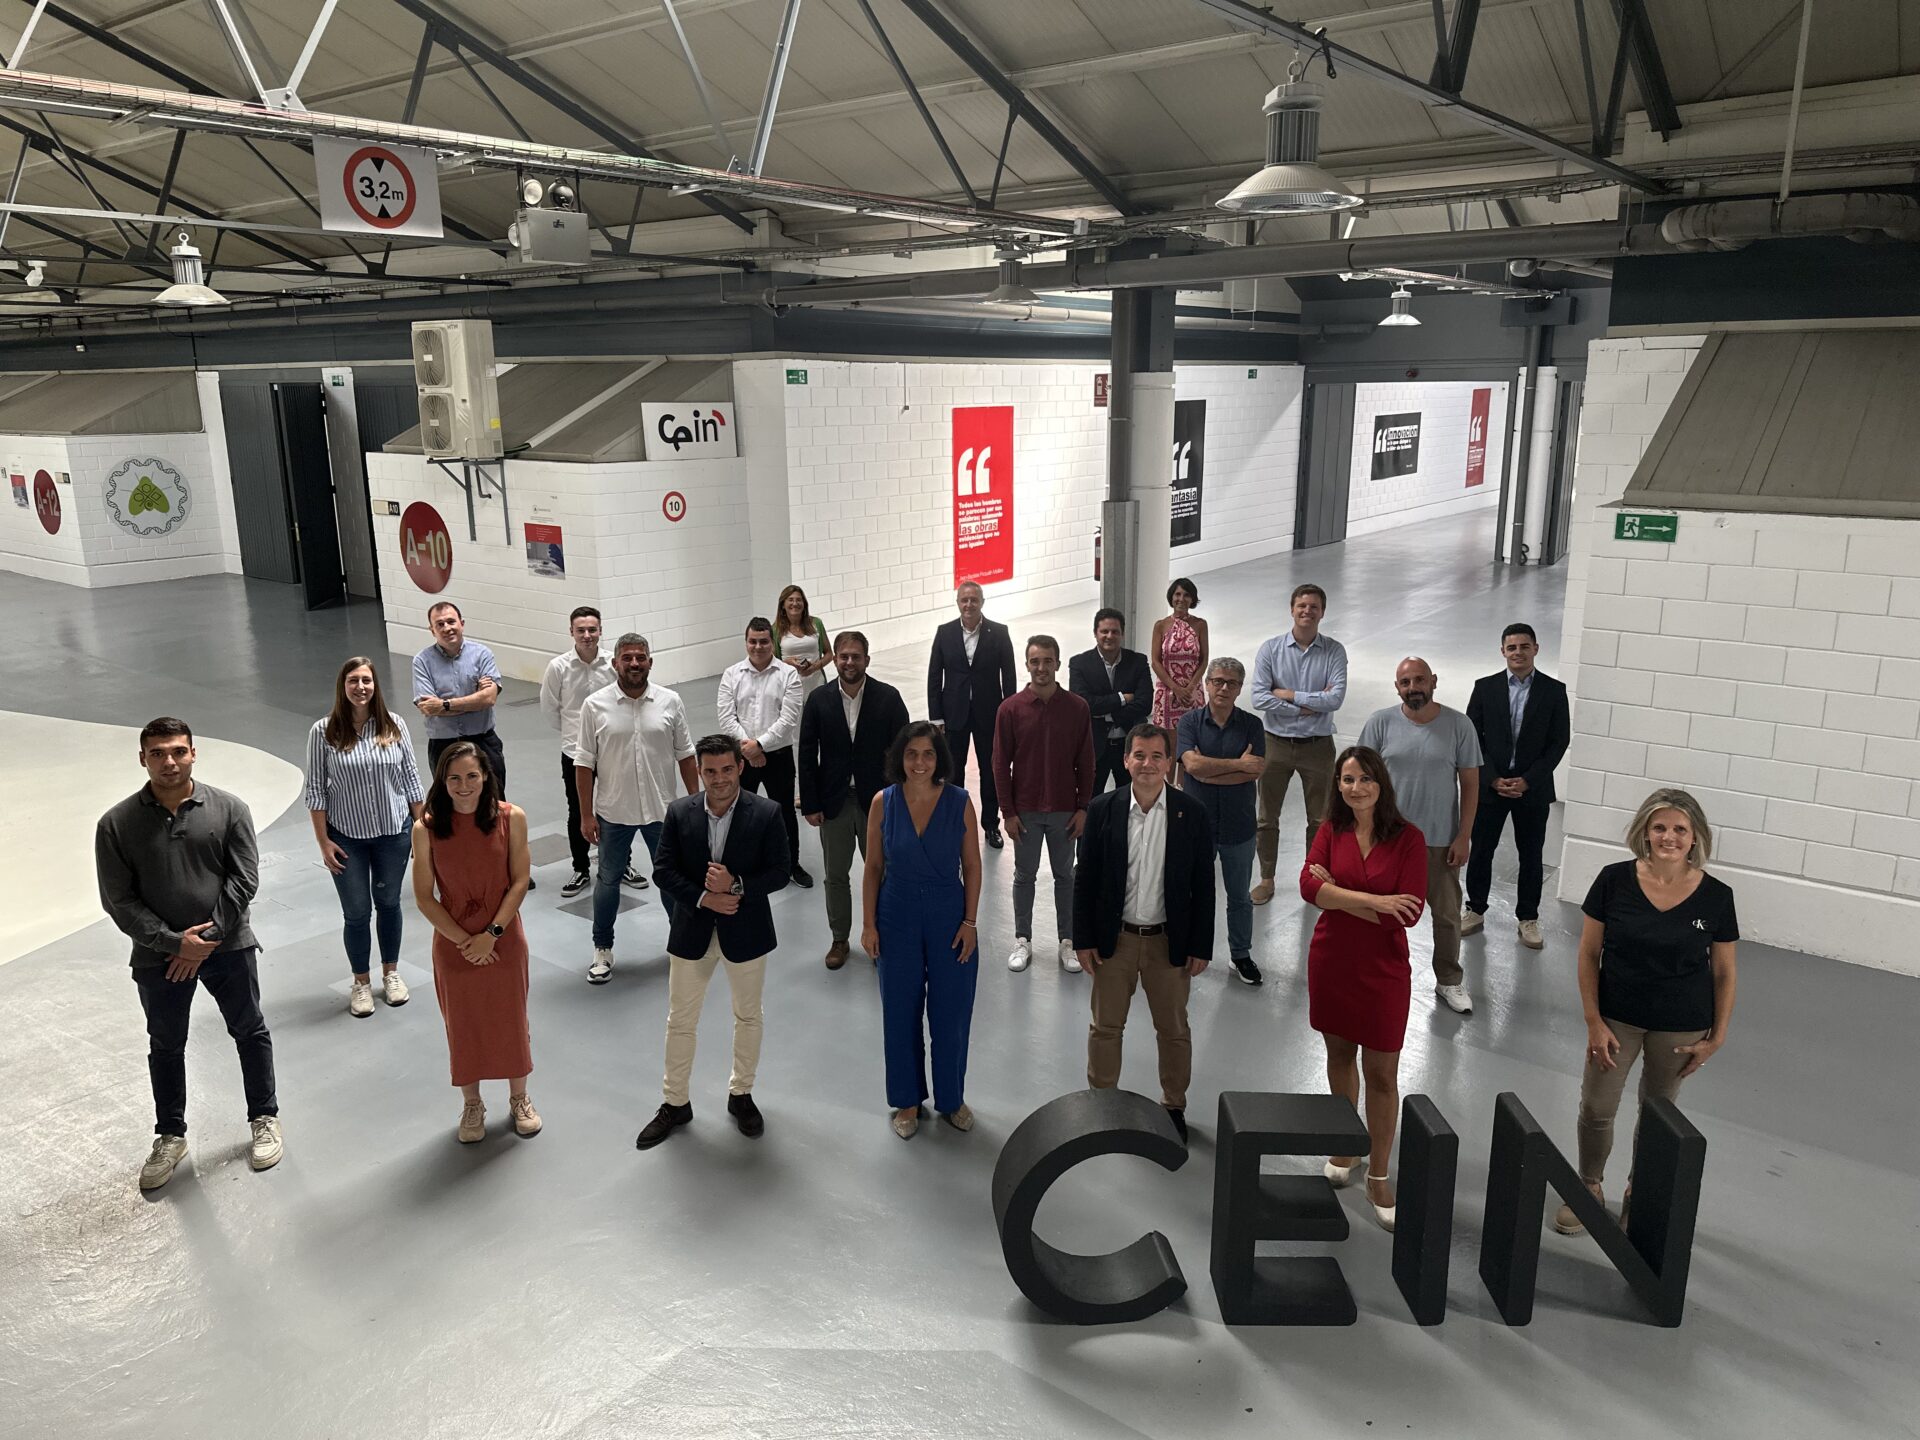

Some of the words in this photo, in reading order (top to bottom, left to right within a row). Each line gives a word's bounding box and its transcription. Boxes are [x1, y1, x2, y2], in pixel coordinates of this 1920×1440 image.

[36, 488, 60, 517] A-12
[669, 501, 680, 511] 10
[959, 524, 972, 535] las
[975, 521, 997, 532] obras
[406, 527, 448, 570] A-10
[992, 1089, 1707, 1327] CEIN
